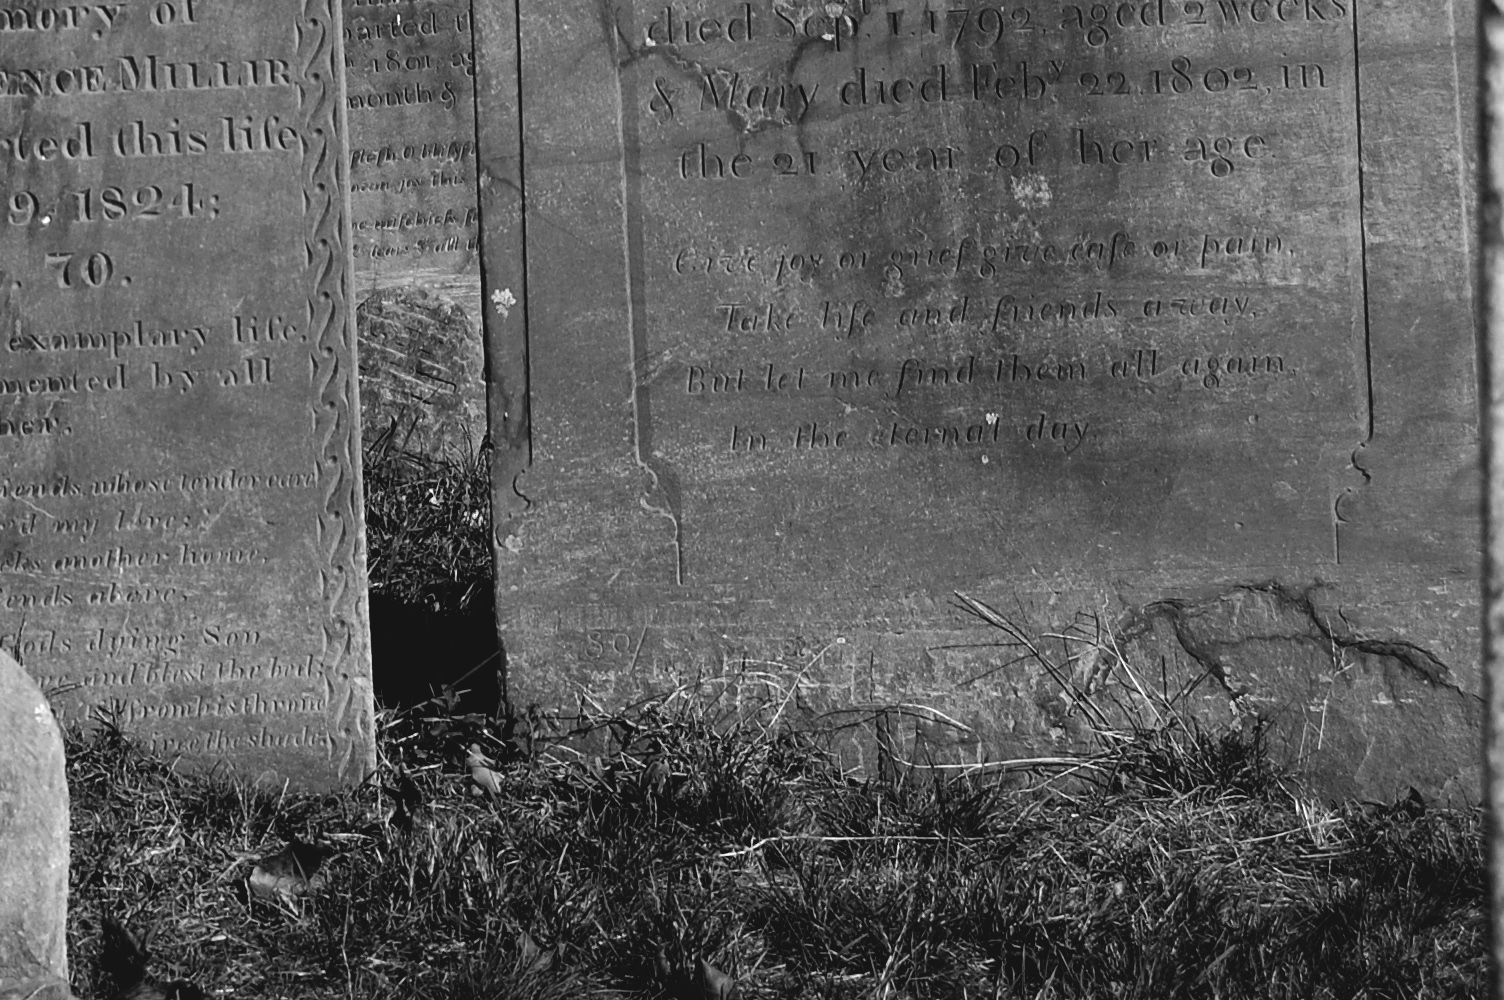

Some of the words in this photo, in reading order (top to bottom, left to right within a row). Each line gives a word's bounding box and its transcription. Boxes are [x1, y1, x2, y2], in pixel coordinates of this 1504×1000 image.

[648, 3, 752, 43] died
[1183, 0, 1207, 25] 2
[648, 77, 682, 125] &
[699, 71, 819, 126] Mary
[840, 64, 946, 105] died
[1279, 53, 1328, 89] in
[113, 118, 208, 157] this
[219, 115, 299, 153] life
[680, 143, 752, 179] the
[854, 147, 962, 181] year
[996, 130, 1047, 168] of
[1074, 129, 1156, 165] her
[45, 252, 132, 288] 70.
[839, 251, 867, 269] or
[1153, 240, 1180, 257] or
[716, 303, 794, 331] Take
[899, 296, 968, 326] and
[151, 361, 202, 395] by
[218, 357, 273, 387] all
[687, 365, 744, 393] But
[766, 363, 806, 390] let
[828, 369, 879, 388] me
[996, 354, 1085, 382] them
[1112, 349, 1157, 377] all
[730, 425, 766, 451] In
[794, 421, 847, 448] the
[90, 472, 171, 496] whose
[179, 469, 260, 491] tender
[53, 518, 99, 542] my
[52, 545, 169, 571] another
[203, 624, 260, 647] Son
